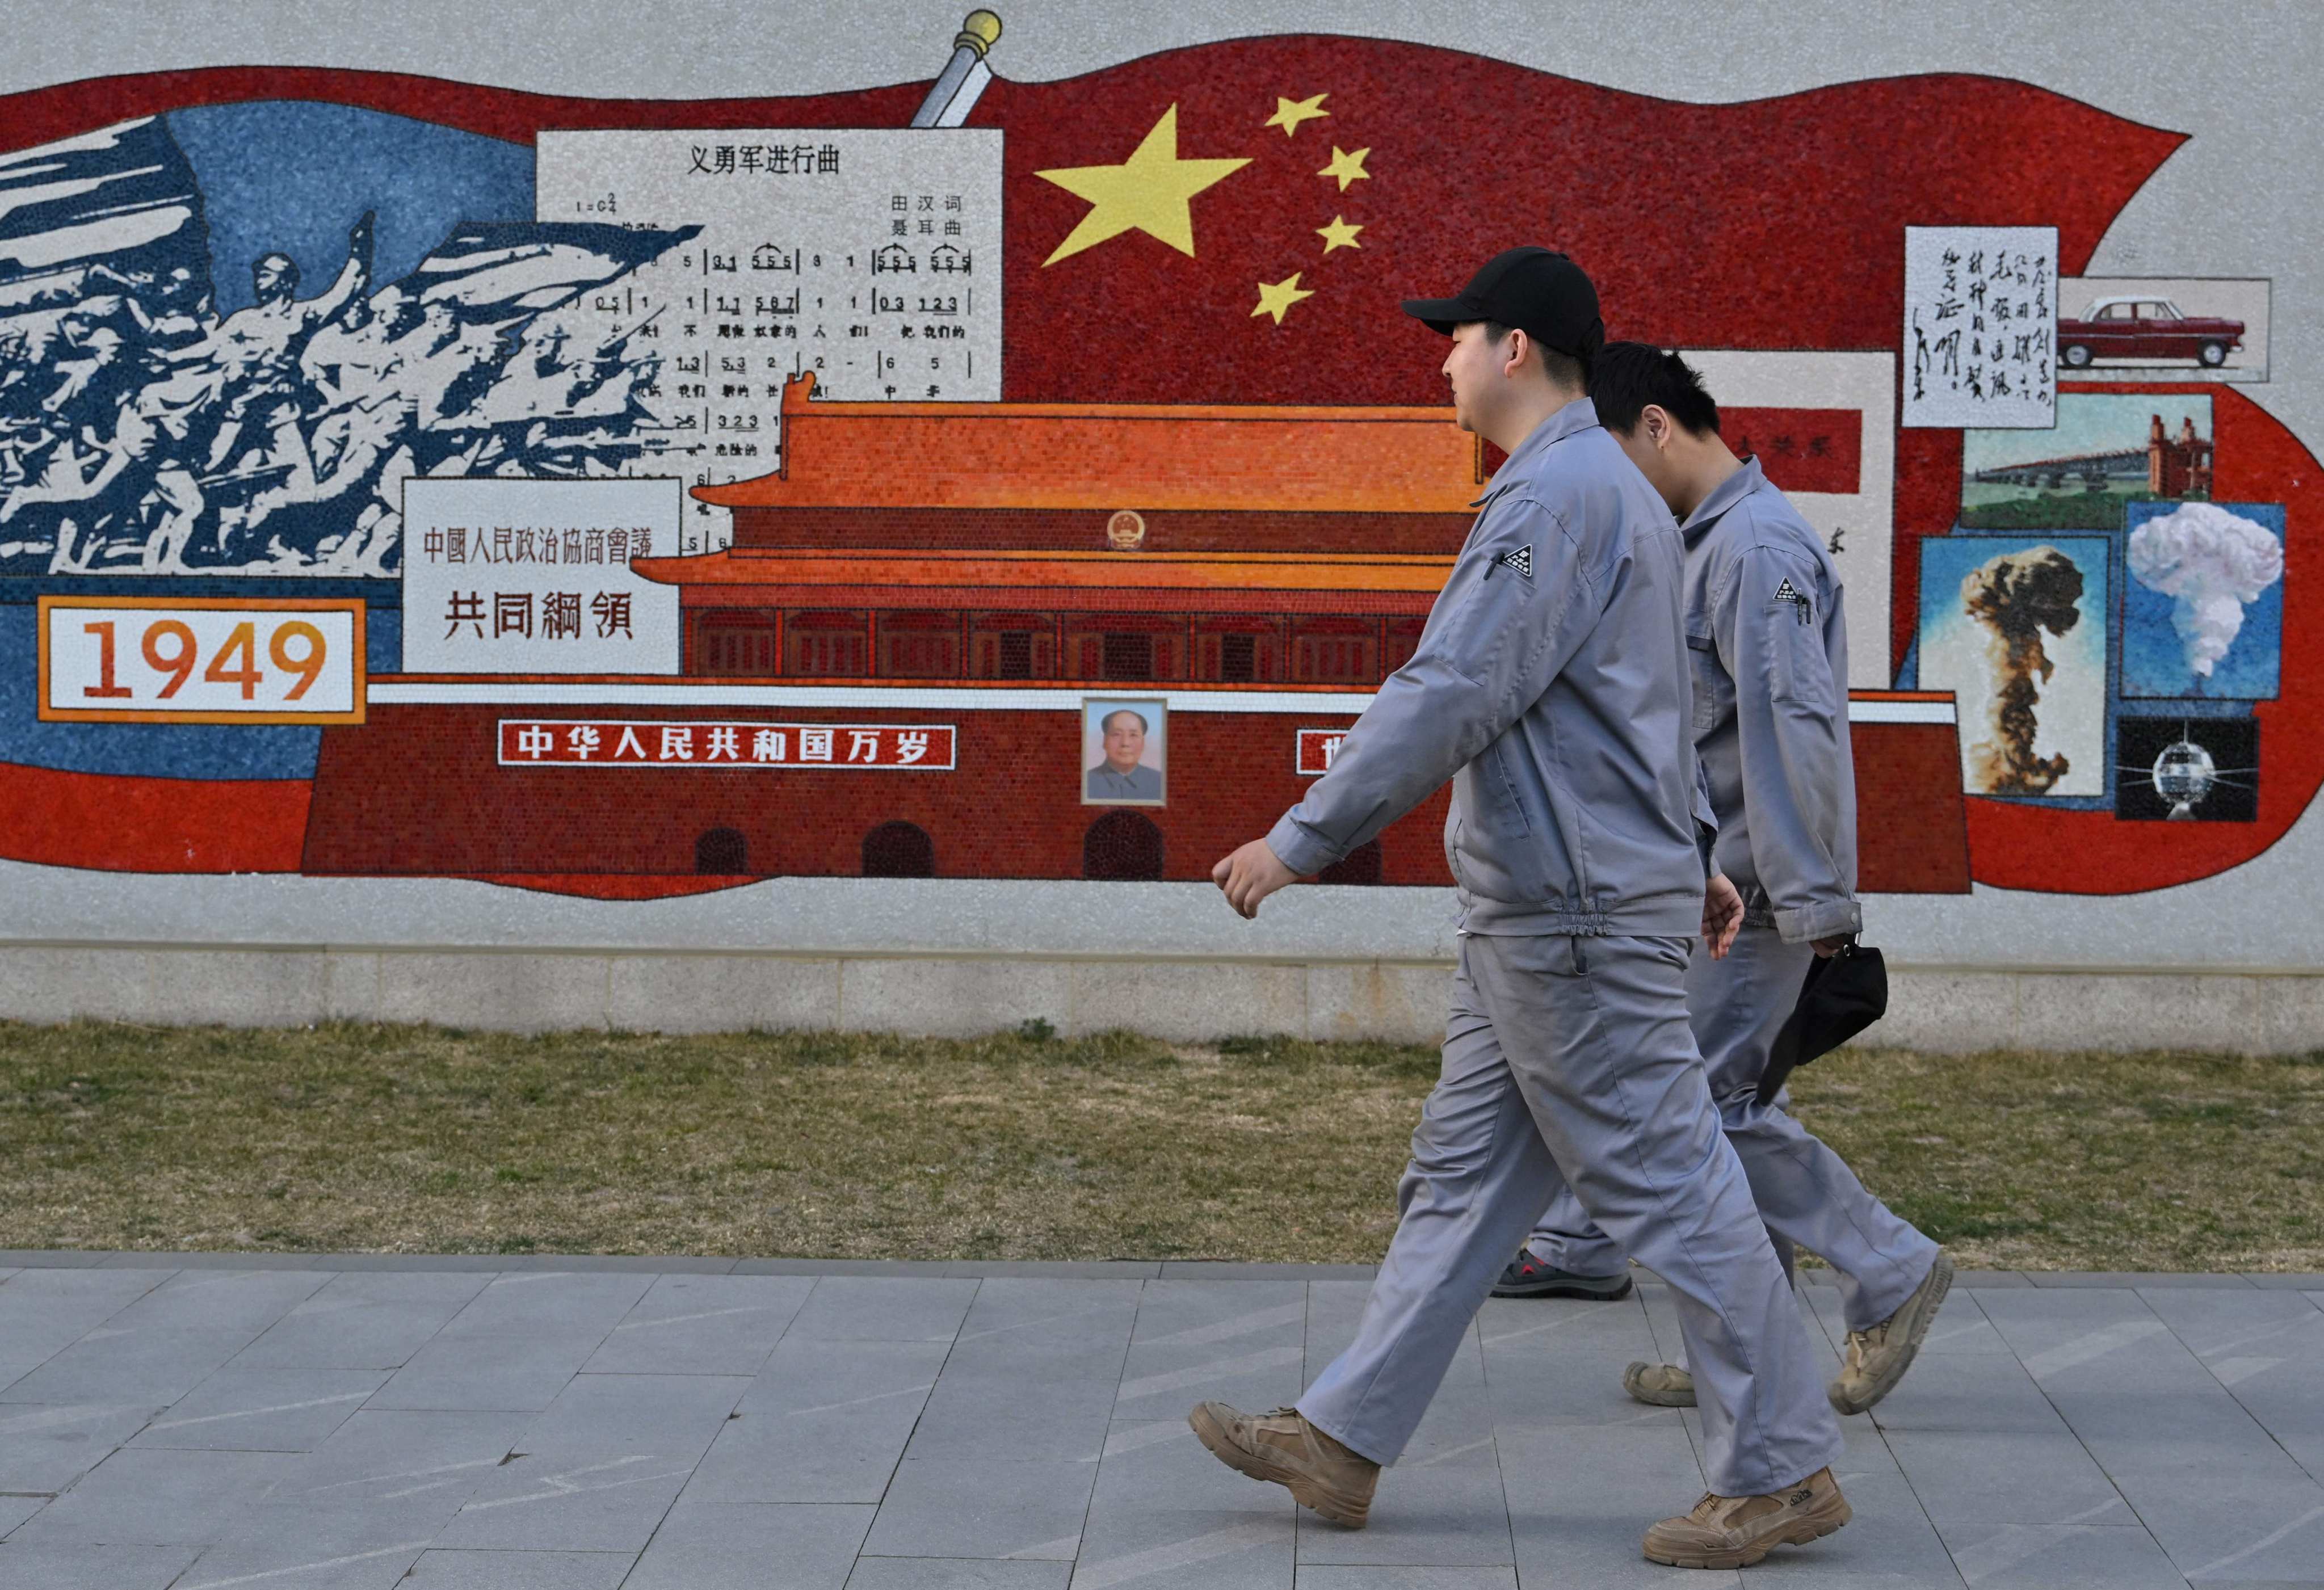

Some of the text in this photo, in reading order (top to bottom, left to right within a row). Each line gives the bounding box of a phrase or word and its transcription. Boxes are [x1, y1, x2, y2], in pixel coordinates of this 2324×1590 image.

[687, 144, 839, 175] 义勇军进行曲
[891, 195, 962, 212] 田汉词
[890, 218, 961, 236] 聂耳曲
[423, 526, 653, 565] 中國人民政治協商會議
[444, 590, 634, 640] 共同綱領
[82, 619, 327, 701] 1949
[518, 725, 931, 765] 中华人民共和国万岁
